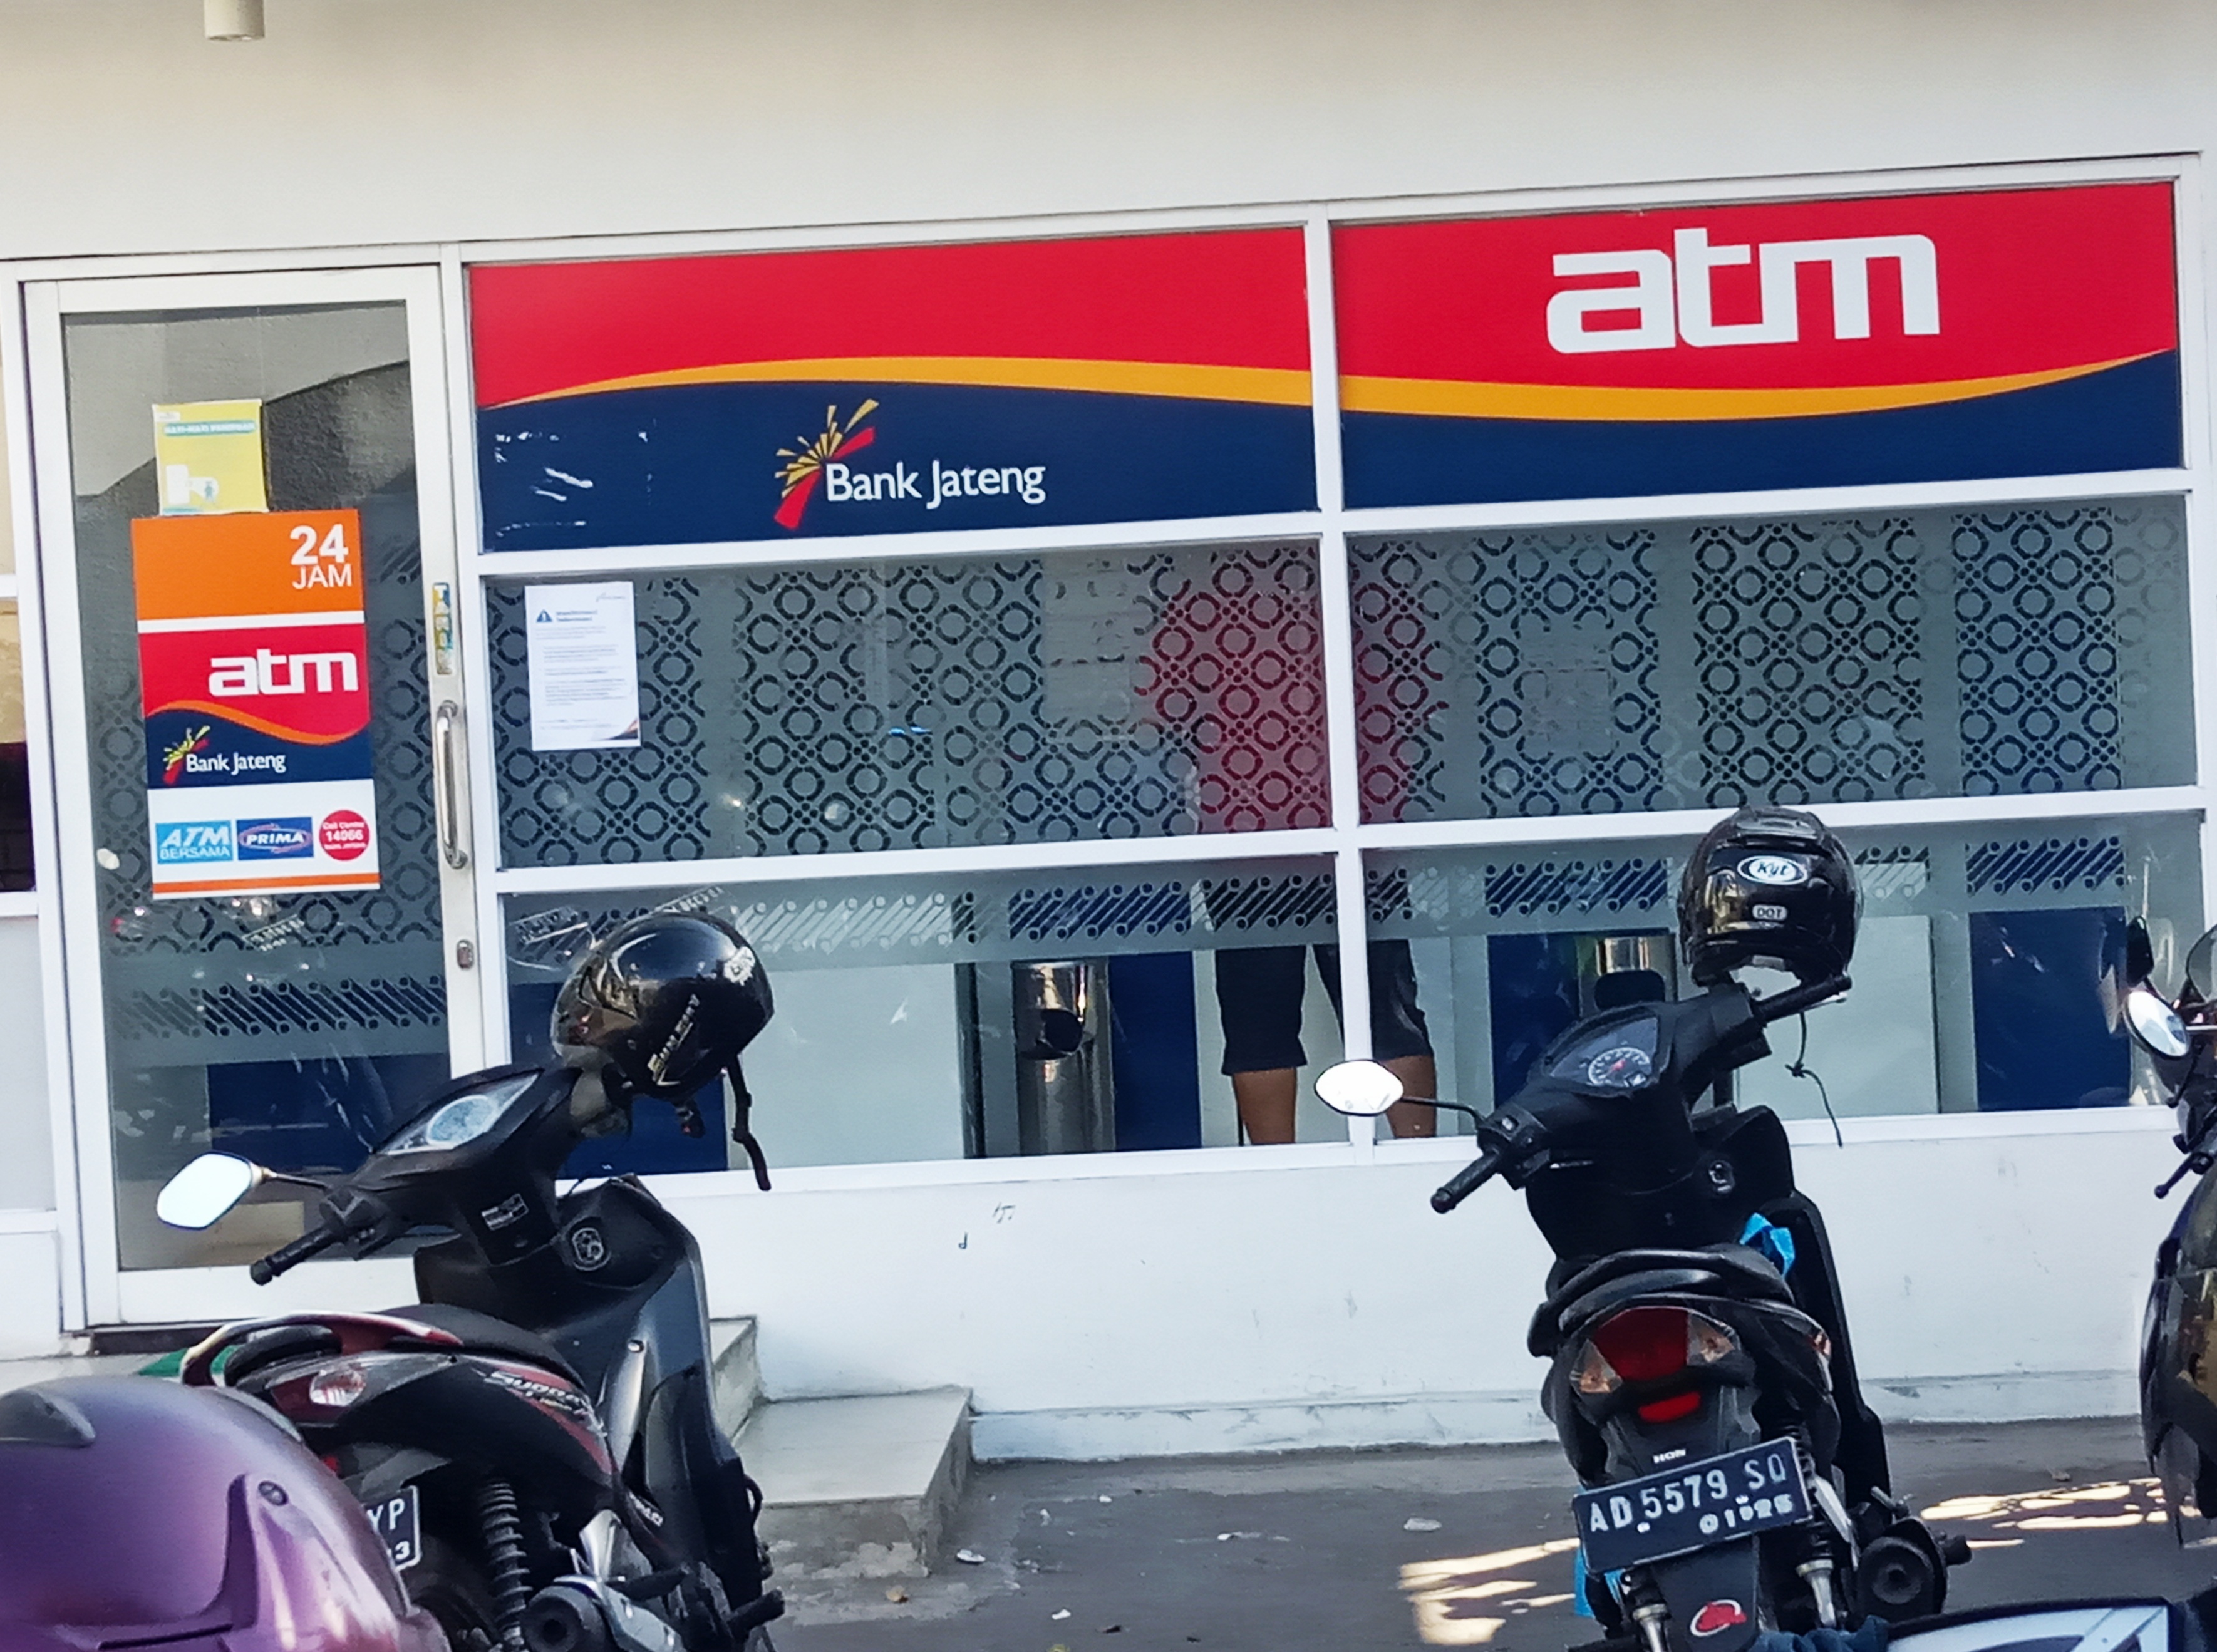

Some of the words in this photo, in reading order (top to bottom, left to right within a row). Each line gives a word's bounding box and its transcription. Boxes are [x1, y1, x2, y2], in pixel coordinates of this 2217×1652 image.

[1546, 227, 1940, 354] atm
[825, 461, 922, 502] Bank
[926, 459, 1046, 510] Jateng
[290, 524, 349, 565] 24
[291, 564, 352, 589] JAM
[208, 648, 359, 697] atm
[186, 753, 230, 773] Bank
[231, 752, 287, 775] Jateng
[161, 826, 230, 848] ATM
[247, 832, 304, 845] PRIMA
[159, 846, 230, 860] BERSAMA
[1757, 907, 1782, 917] DOT
[1590, 1496, 1633, 1532] AD
[1640, 1469, 1729, 1519] 5579
